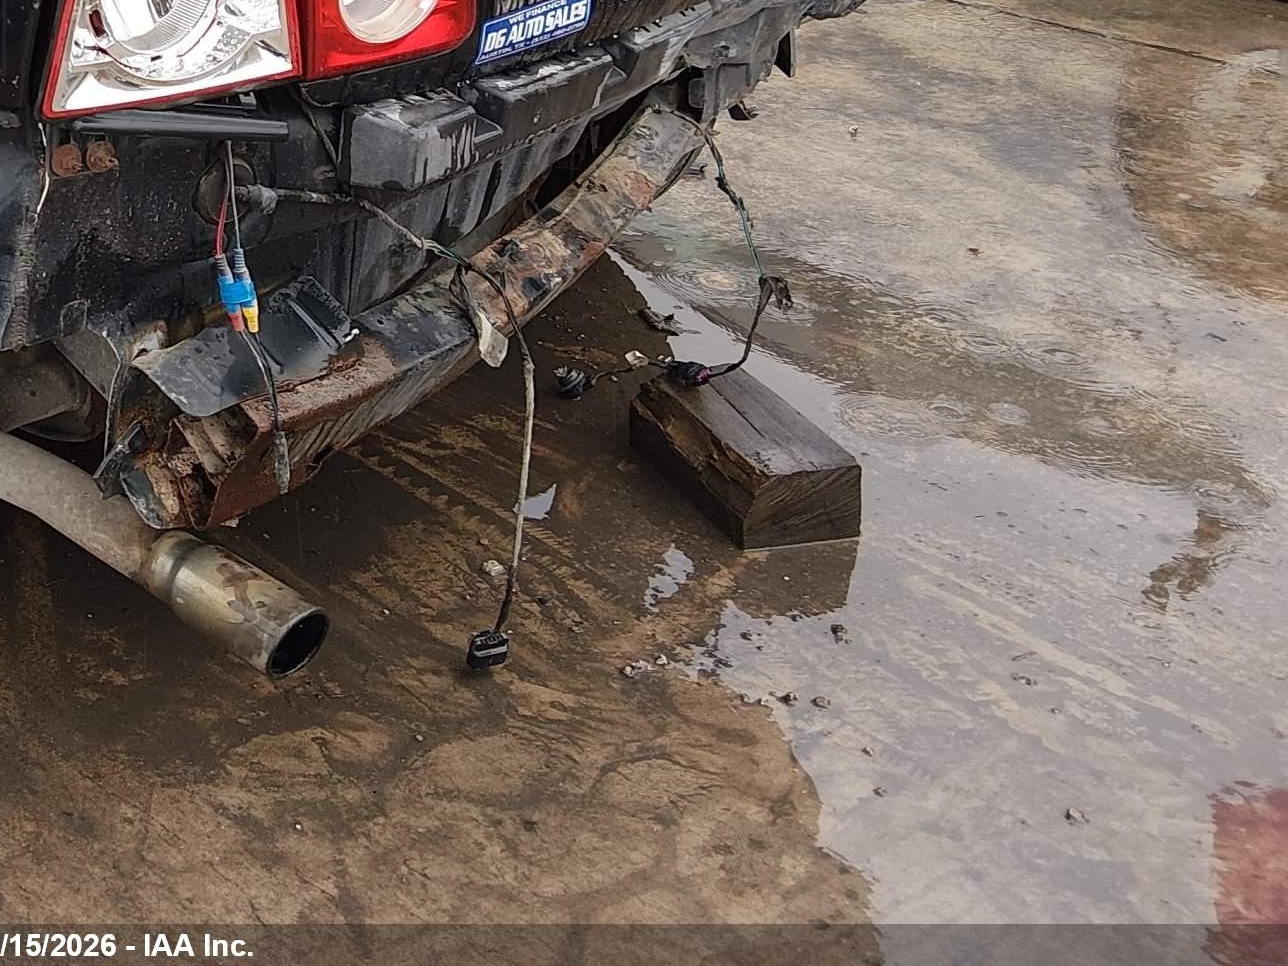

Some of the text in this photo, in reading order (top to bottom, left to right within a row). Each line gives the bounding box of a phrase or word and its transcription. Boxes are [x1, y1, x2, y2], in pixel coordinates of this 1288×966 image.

[506, 16, 545, 46] AUTO
[544, 0, 588, 32] SALES
[509, 15, 525, 25] WE
